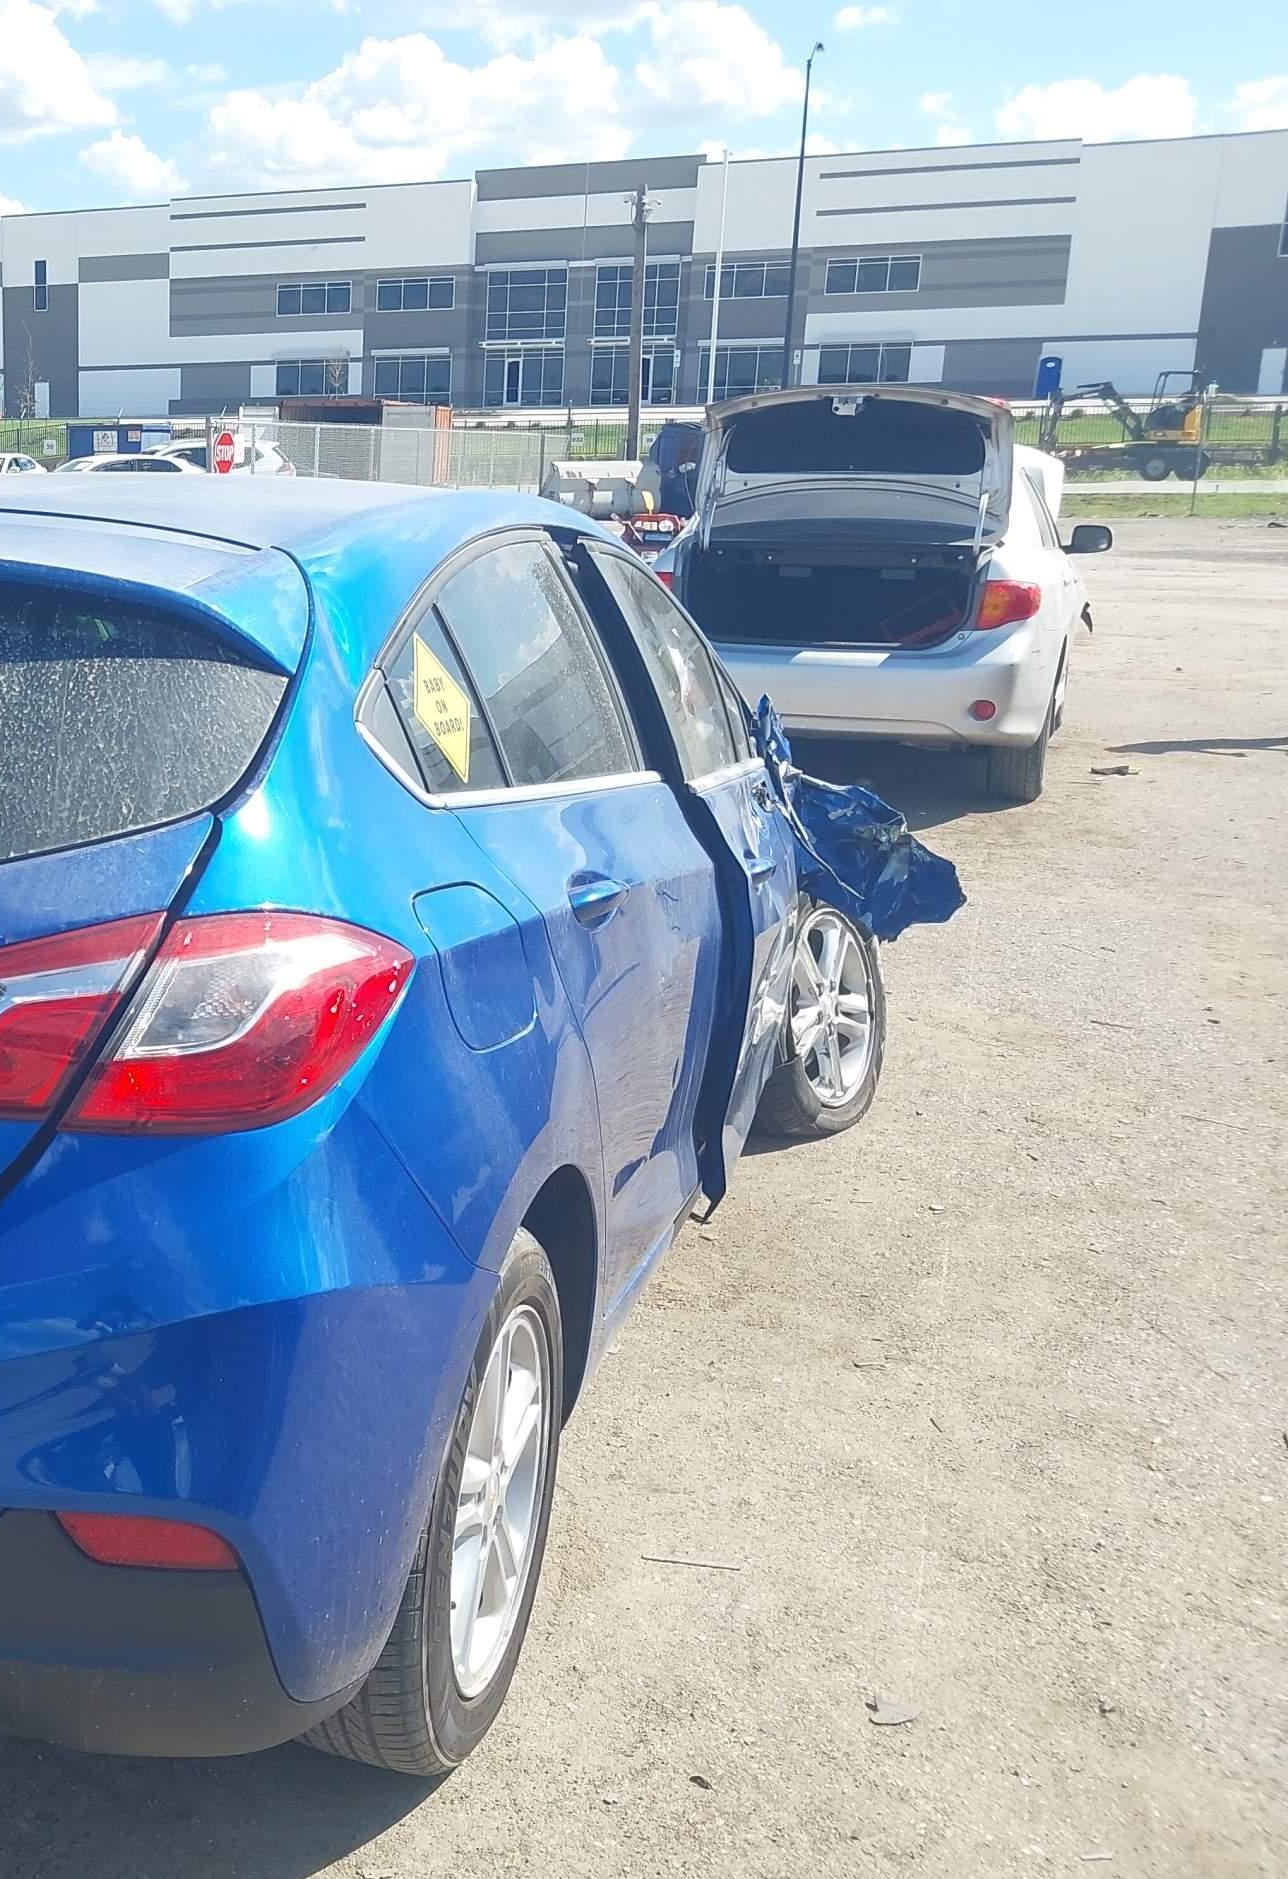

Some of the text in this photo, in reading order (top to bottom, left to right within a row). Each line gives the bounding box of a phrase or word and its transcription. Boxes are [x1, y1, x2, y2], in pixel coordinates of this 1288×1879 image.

[216, 444, 234, 461] STOP
[423, 676, 444, 693] BABY
[435, 699, 448, 714] ON
[433, 717, 465, 737] BOARD!
